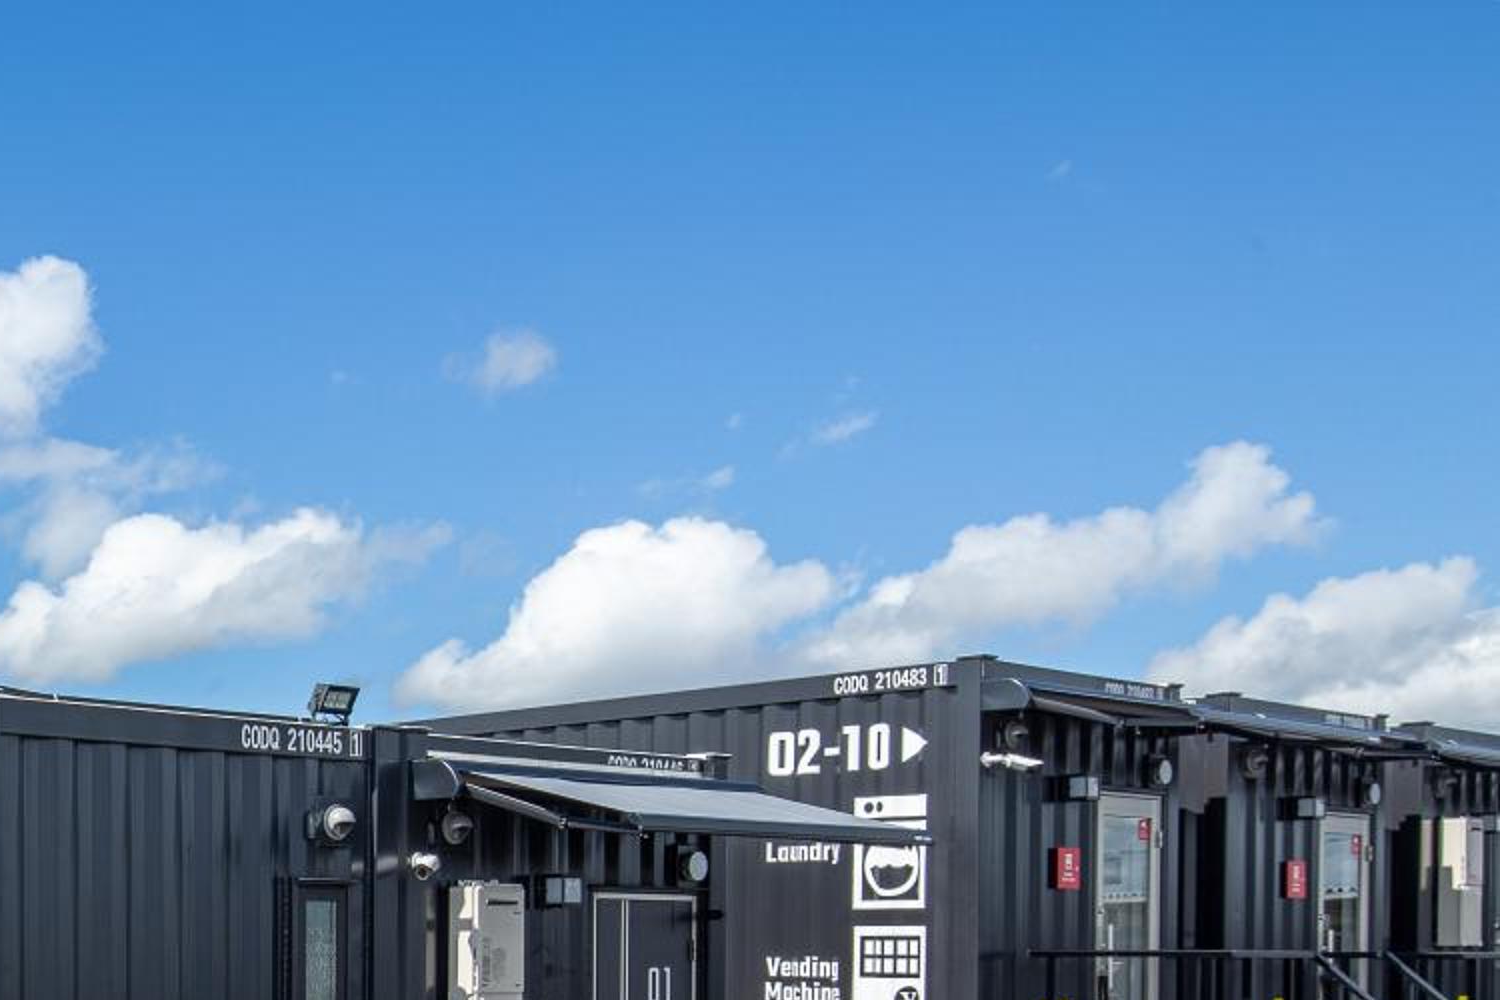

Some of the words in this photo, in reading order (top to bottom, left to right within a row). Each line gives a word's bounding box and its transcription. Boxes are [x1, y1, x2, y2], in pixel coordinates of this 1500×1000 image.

[833, 675, 868, 695] CODQ
[875, 667, 927, 689] 210483
[241, 724, 280, 750] CODQ
[287, 727, 342, 754] 210445
[768, 723, 891, 777] 02-10
[765, 842, 840, 864] Laundry
[765, 956, 840, 981] Vending
